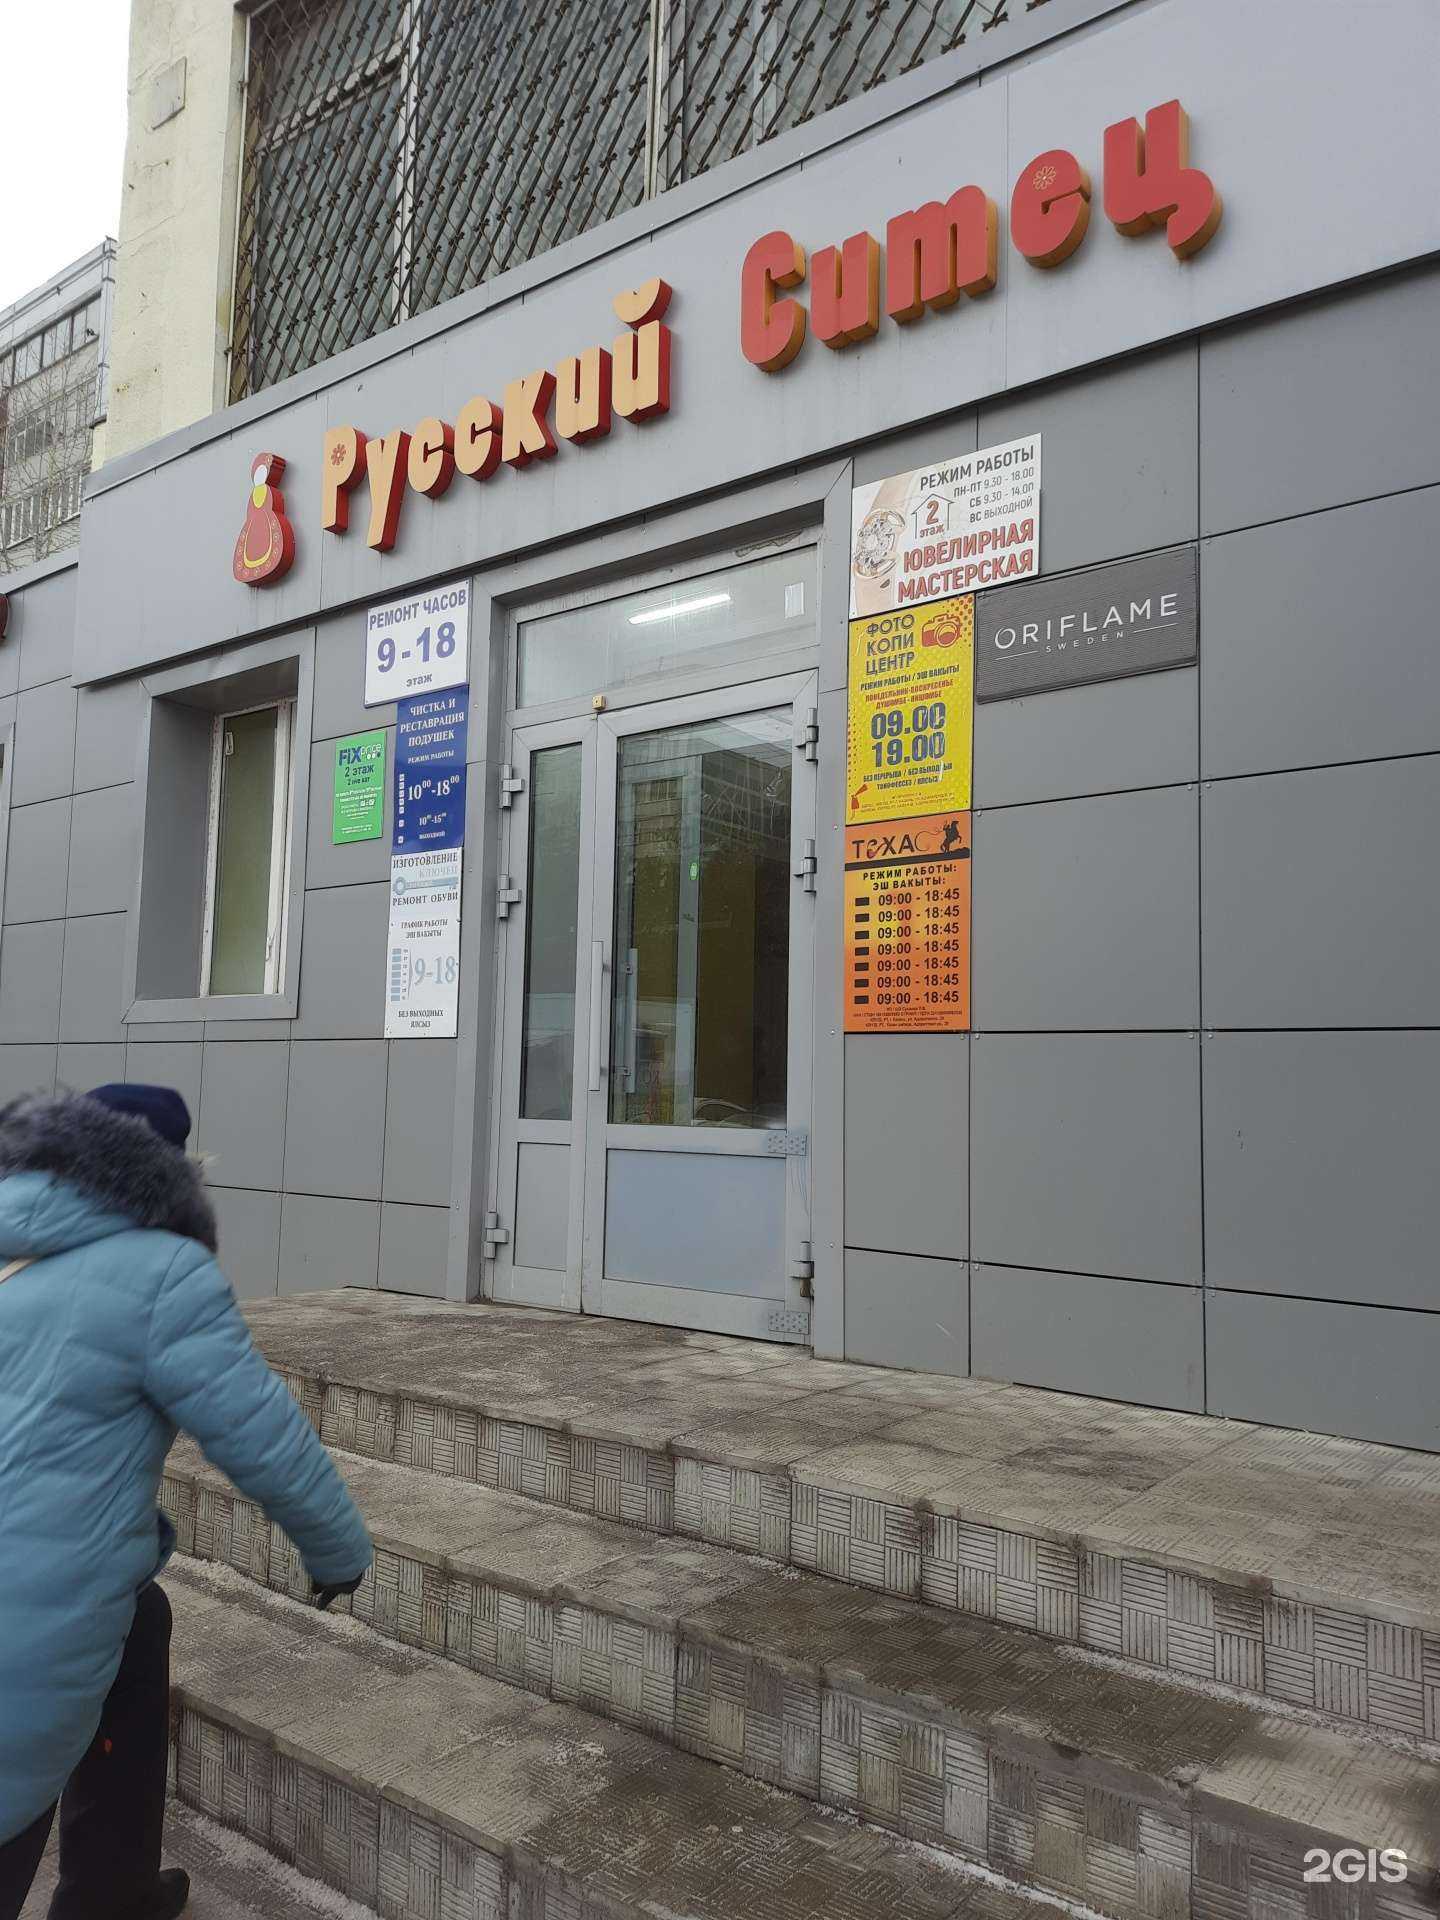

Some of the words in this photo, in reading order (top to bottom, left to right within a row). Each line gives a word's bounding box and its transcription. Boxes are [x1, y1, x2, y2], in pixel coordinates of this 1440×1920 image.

[322, 277, 673, 552] Русский
[740, 98, 1223, 373] Ситец
[920, 463, 972, 491] РЕЖИМ
[976, 445, 1034, 475] РАБОТЫ
[954, 481, 982, 497] ПН-ПТ
[984, 475, 1002, 489] 9.30
[1011, 467, 1034, 481] 18.00
[970, 496, 982, 508] СБ
[984, 490, 1002, 504] 9.30
[926, 500, 939, 525] 2
[970, 511, 982, 523] ВС
[984, 496, 1033, 519] ВЫХОДНОЙ
[919, 524, 945, 538] этаж
[903, 518, 1034, 573] ЮВЕЛИРНАЯ
[897, 548, 1033, 604] МАСТЕРСКАЯ
[369, 602, 420, 631] РЕМОНТ
[423, 589, 467, 615] ЧАСОВ
[866, 614, 915, 637] ФОТО
[994, 592, 1179, 650] ORIFLAME
[866, 632, 914, 657] КОПИ
[1045, 631, 1124, 653] SWEDEN
[866, 651, 915, 676] ЦЕНТР
[406, 673, 433, 687] этаж
[883, 675, 911, 688] РАБОТЫ
[410, 700, 446, 716] ЧИСТКА
[448, 698, 456, 709] И
[400, 711, 465, 734] РЕСТАВРАЦИЯ
[871, 702, 947, 740] 09.00
[408, 729, 455, 747] ПОДУШЕК
[871, 731, 946, 768] 19.00
[344, 766, 350, 778] 2
[392, 852, 458, 869] ИЗГОТОВЛЕНИЕ
[863, 869, 902, 880] РЕЖИМ
[905, 864, 957, 877] РАБОТЫ:
[872, 881, 889, 891] ЭШ
[893, 876, 946, 889] ВАКЫТЫ:
[392, 895, 428, 906] РЕМОНТ
[430, 892, 458, 903] ОБУВИ
[878, 892, 912, 906] 09:00
[924, 888, 960, 902] 18:45
[878, 909, 912, 923] 09:00
[924, 905, 960, 919] 18:45
[877, 925, 911, 939] 09:00
[924, 922, 960, 936] 18:45
[877, 942, 911, 956] 09:00
[924, 939, 960, 953] 18:45
[414, 955, 457, 986] 9-18
[877, 959, 911, 972] 09:00
[924, 956, 959, 970] 18:45
[877, 975, 911, 988] 09:00
[924, 973, 959, 987] 18:45
[877, 992, 911, 1005] 09:00
[924, 990, 959, 1004] 18:45
